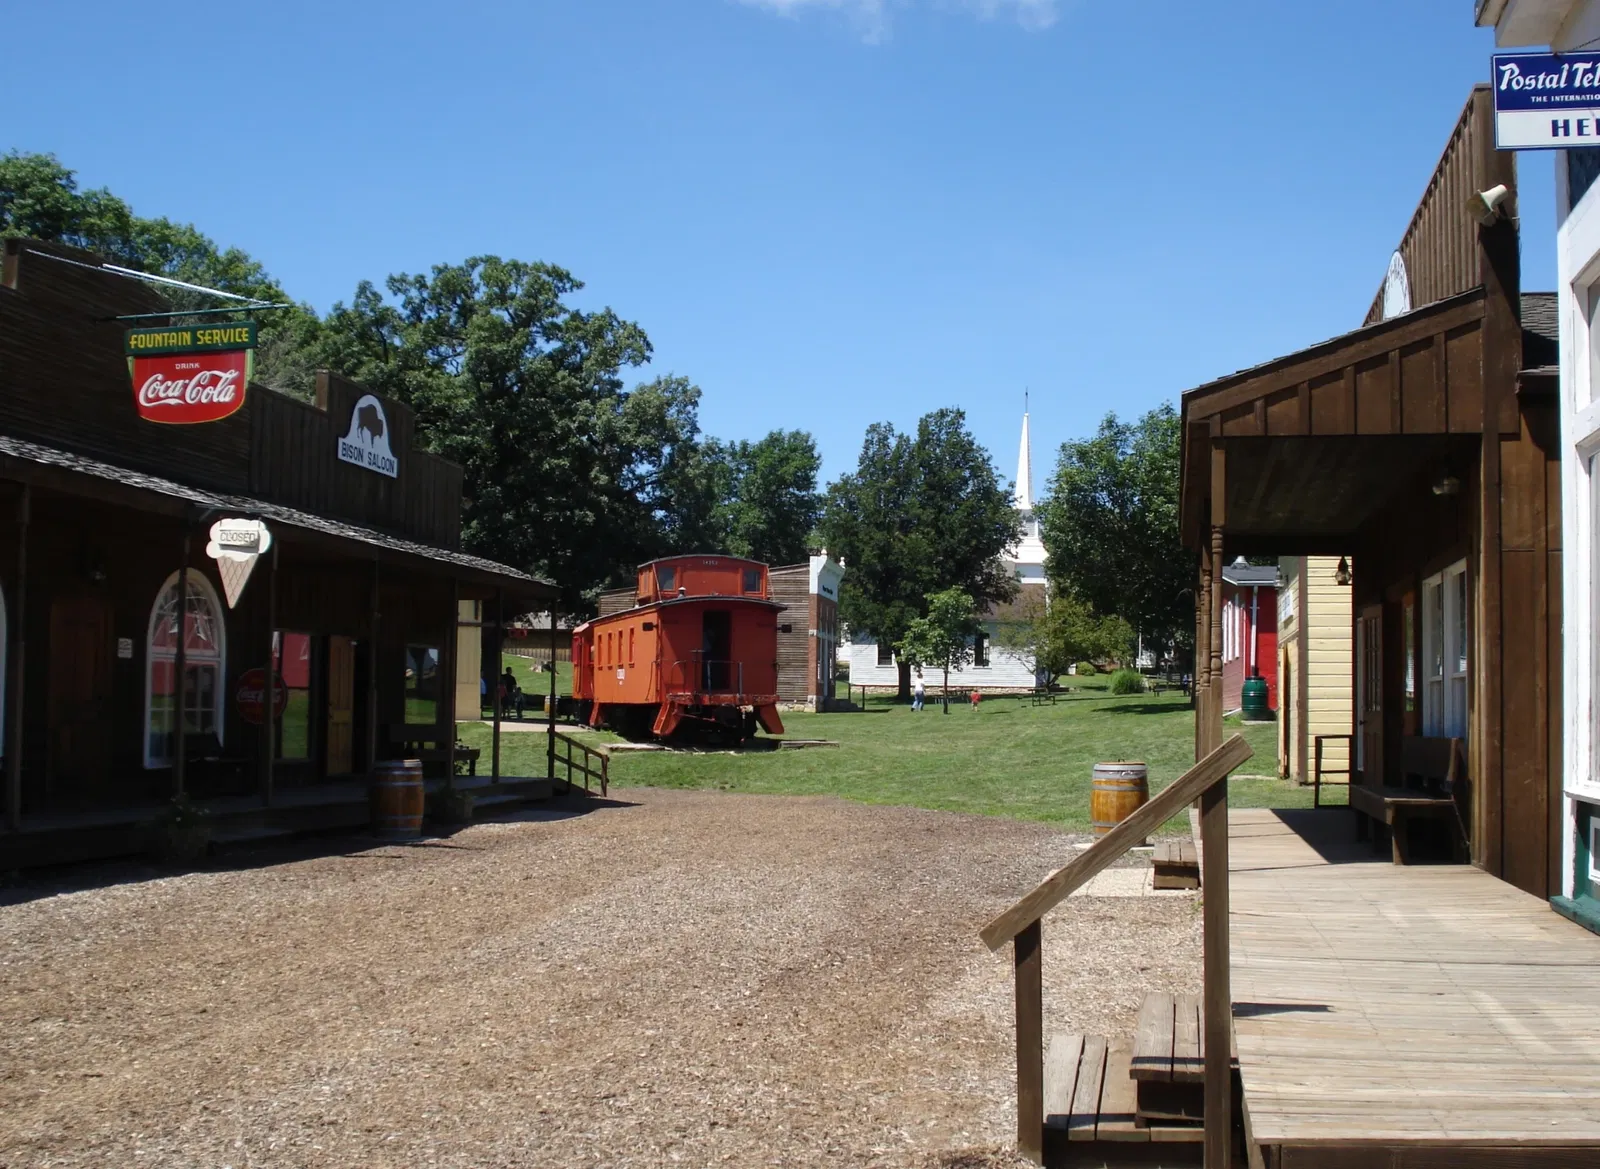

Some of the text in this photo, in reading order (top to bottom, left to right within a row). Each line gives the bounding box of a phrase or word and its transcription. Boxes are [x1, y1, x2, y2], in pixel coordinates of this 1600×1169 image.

[1499, 62, 1569, 91] Postal
[1530, 95, 1548, 103] THE
[129, 328, 249, 348] FOUNTAIN SERVICE
[175, 362, 200, 370] DRINK
[139, 369, 239, 407] Coca-Cola
[341, 441, 395, 474] BISON SALOON
[220, 531, 256, 543] CLOSED
